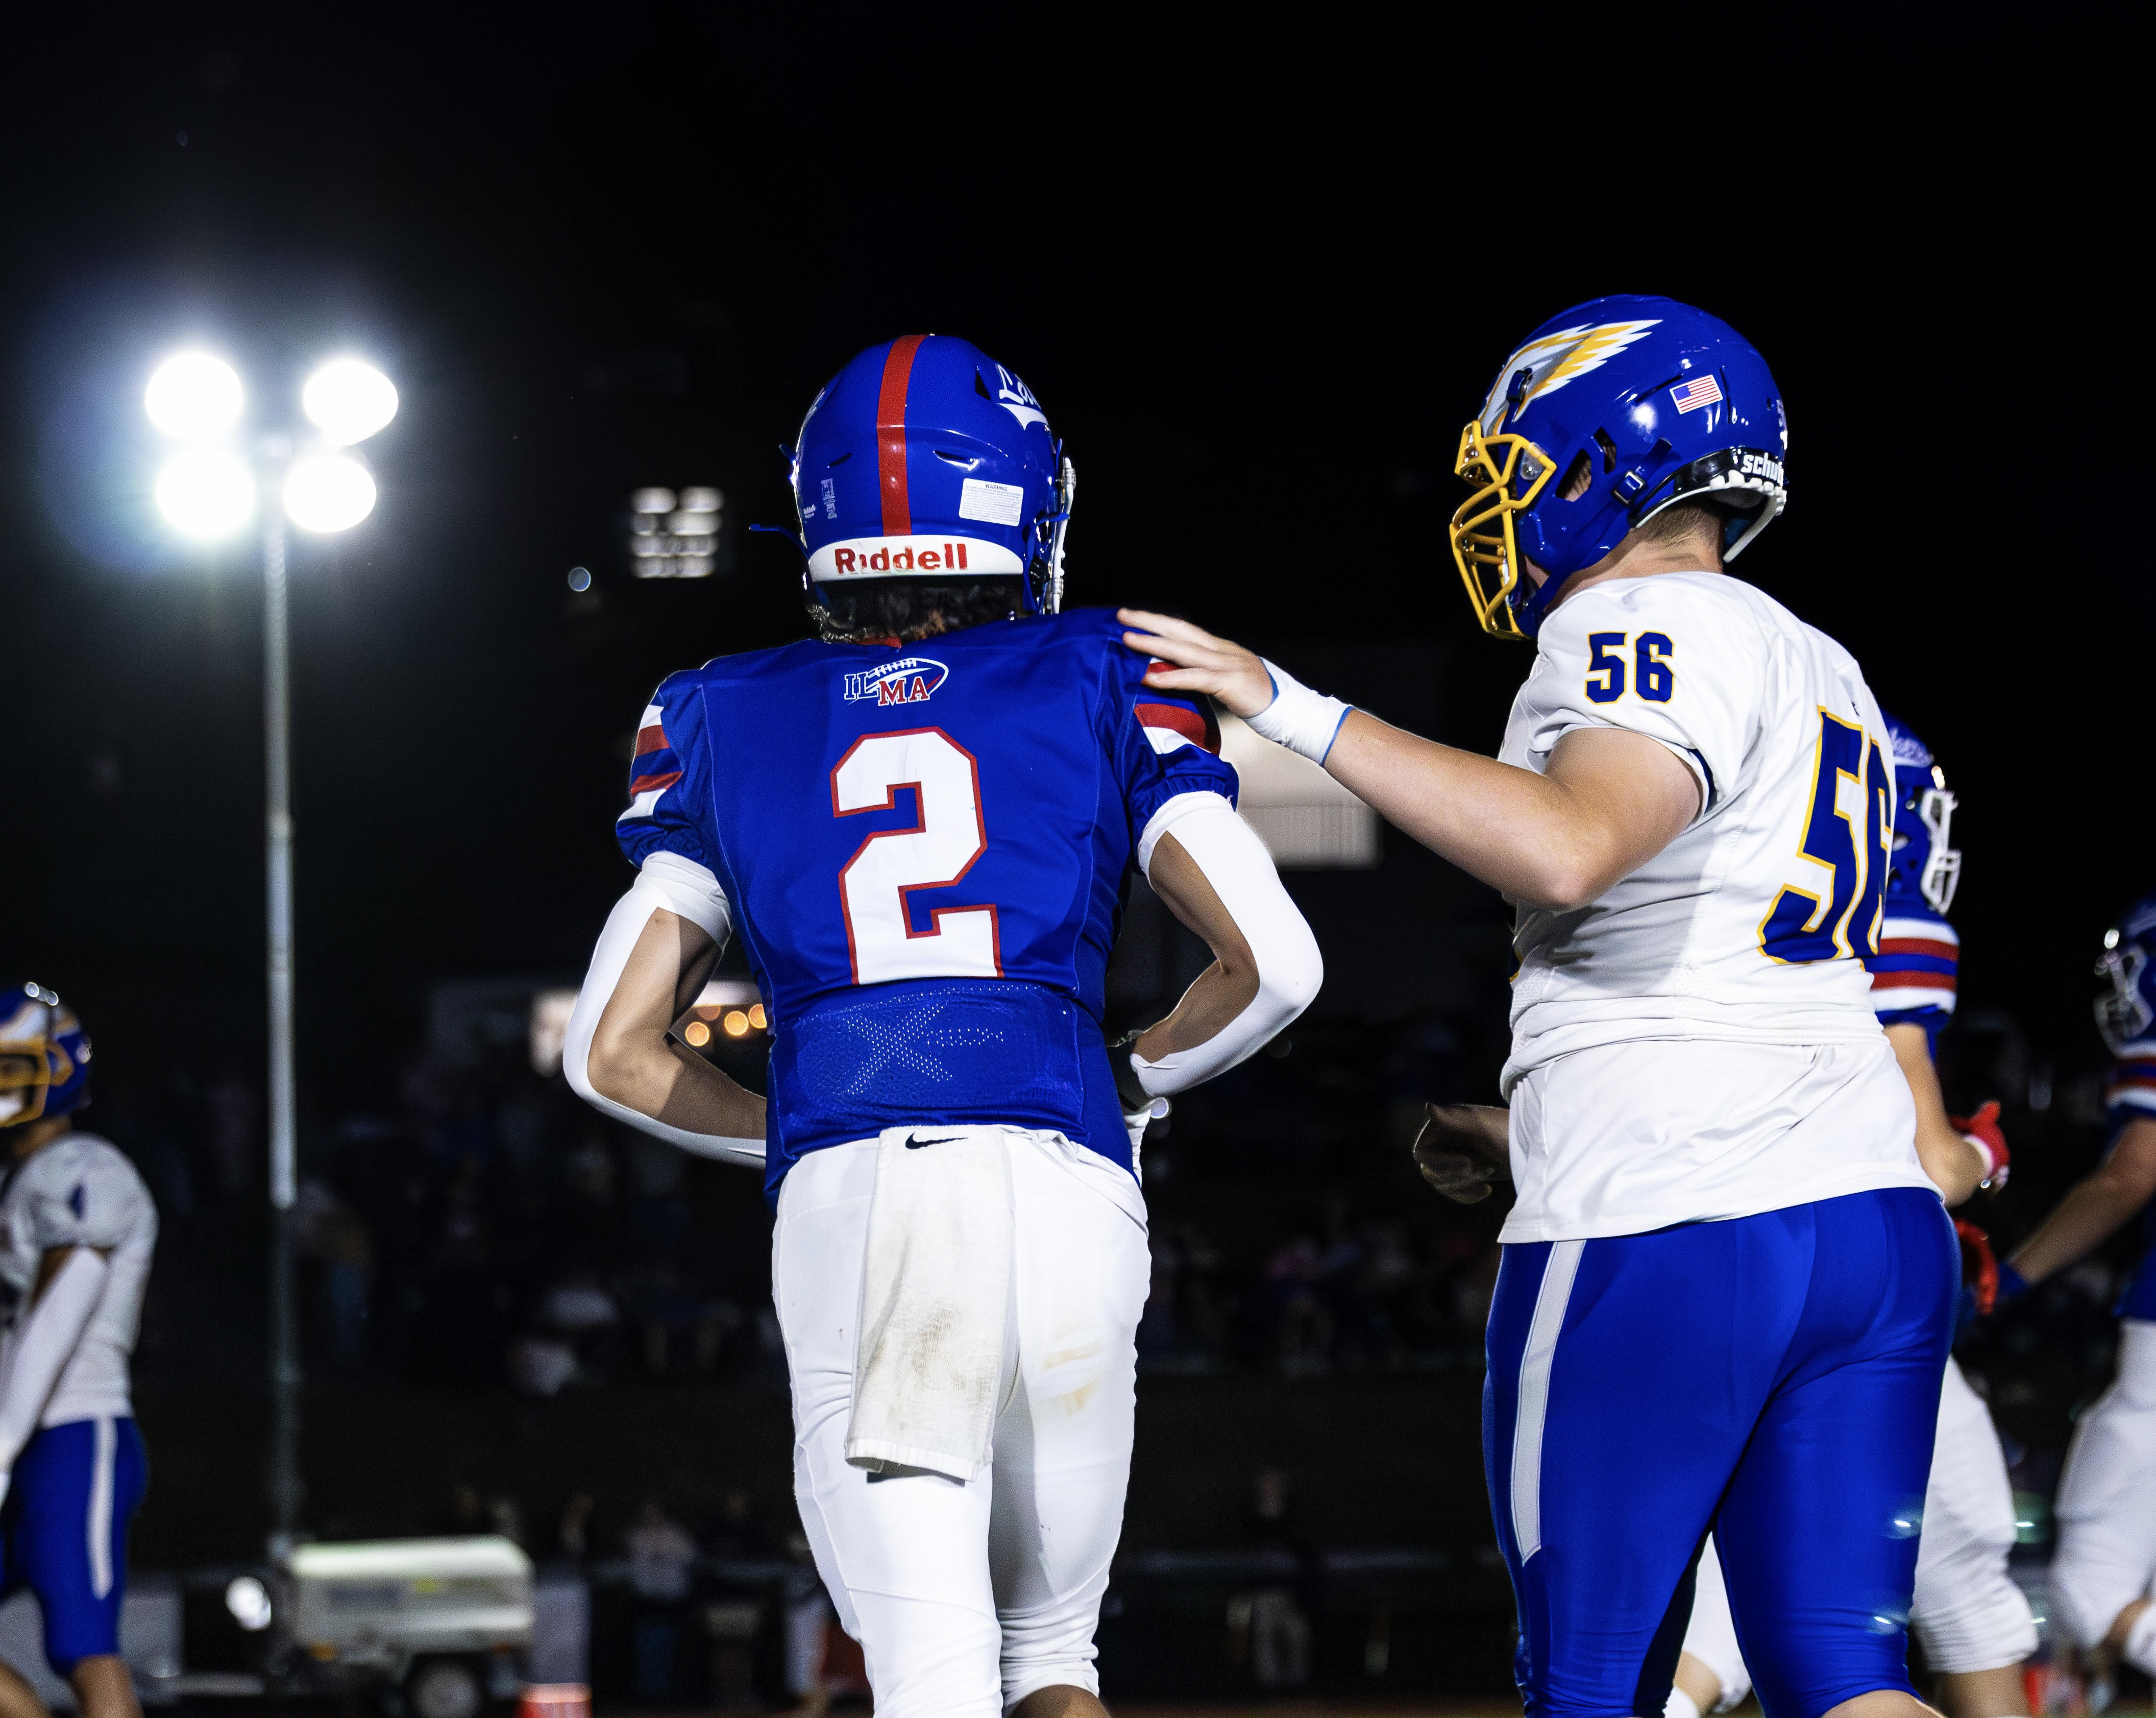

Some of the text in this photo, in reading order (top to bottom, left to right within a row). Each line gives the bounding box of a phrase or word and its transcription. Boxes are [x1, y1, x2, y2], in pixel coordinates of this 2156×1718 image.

[835, 543, 968, 575] Riddell
[1584, 631, 1675, 705] 56
[829, 726, 1004, 985] 2
